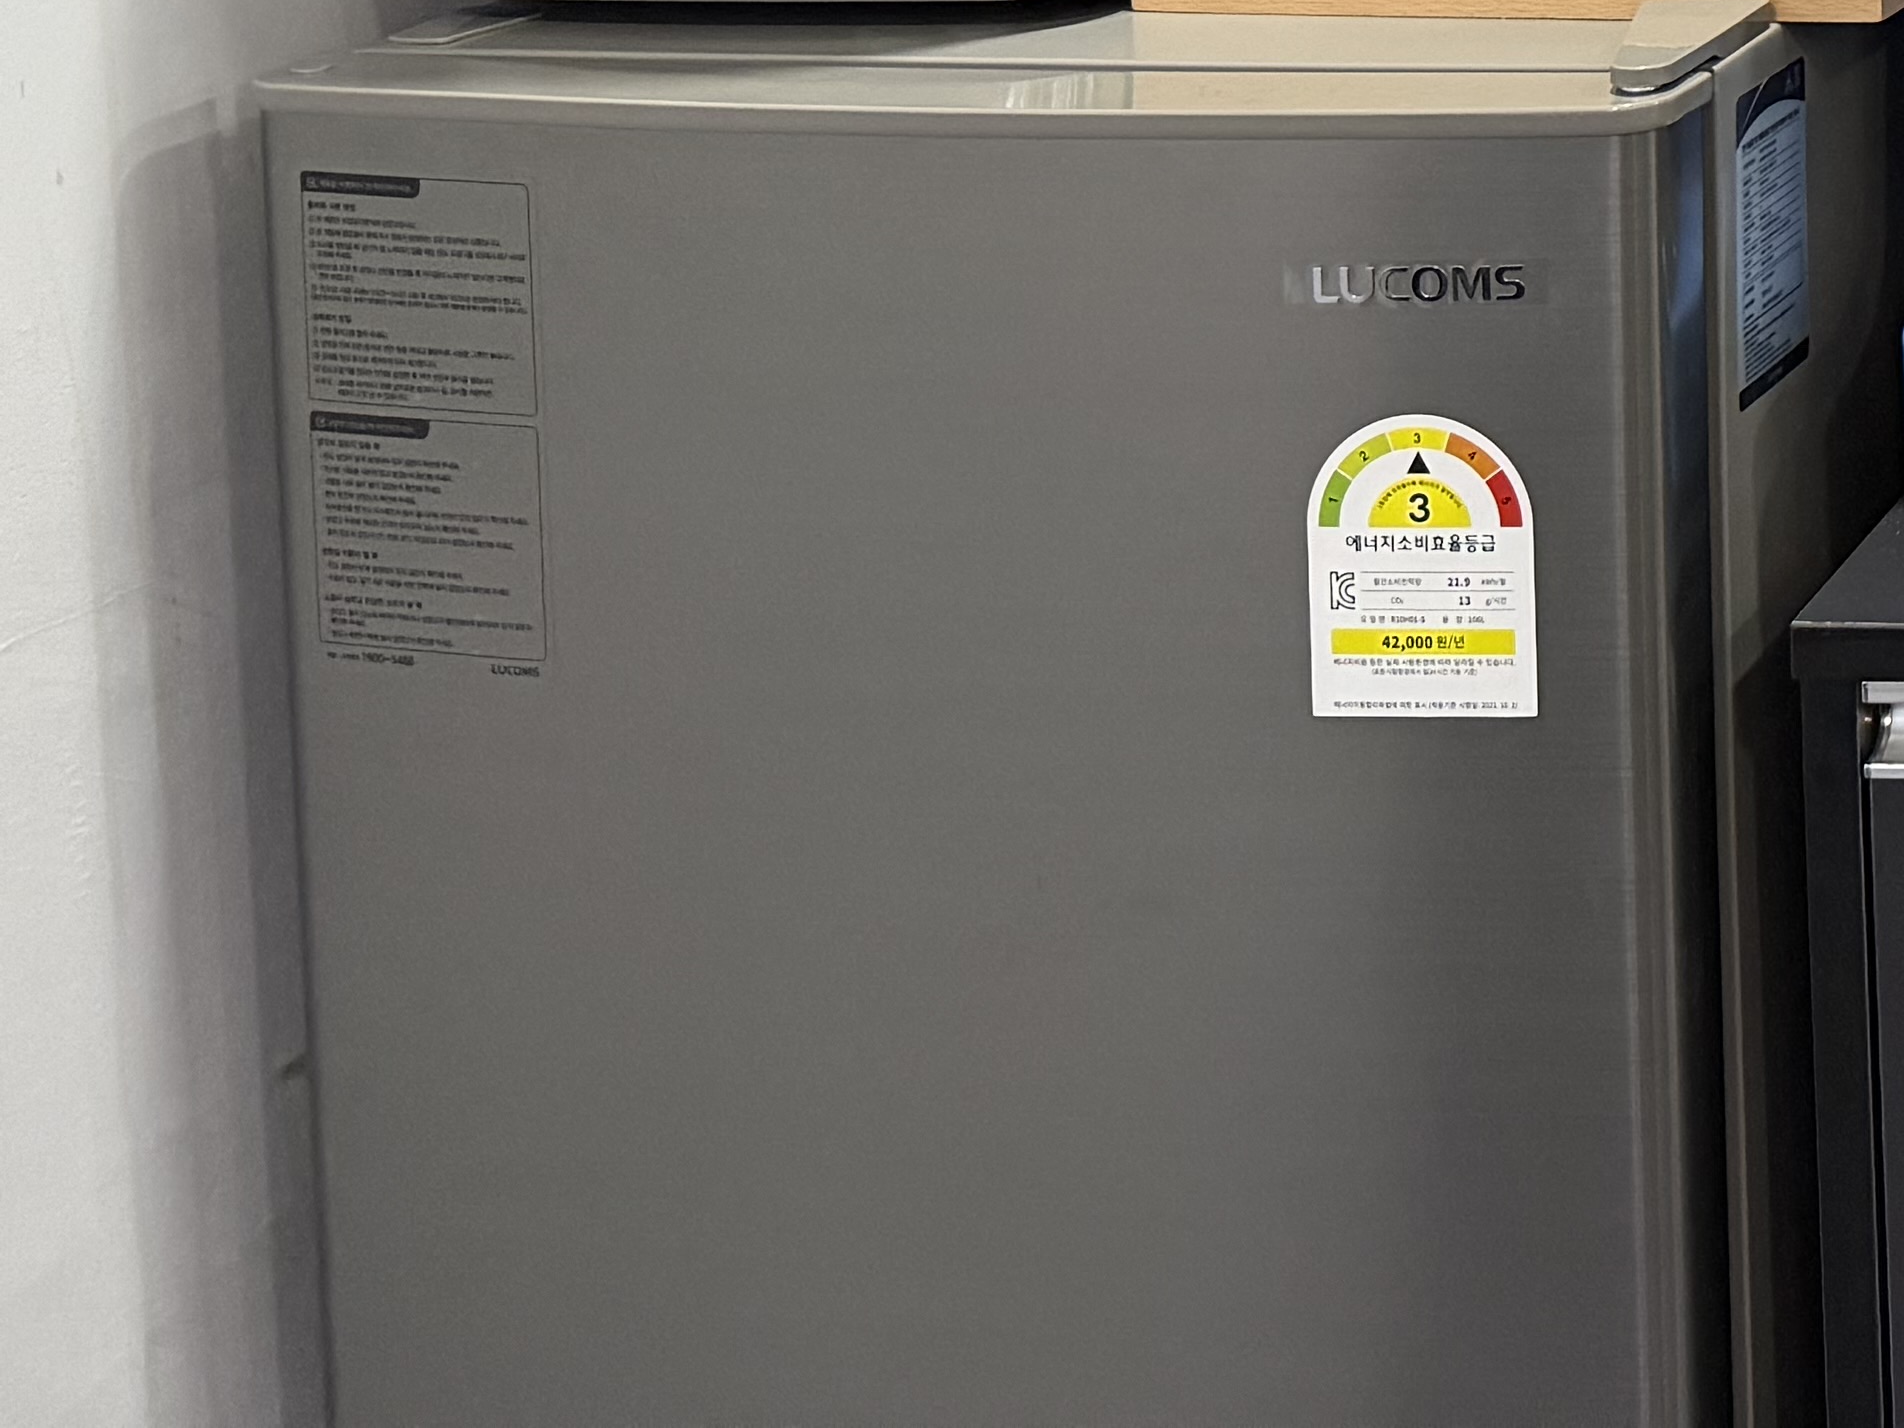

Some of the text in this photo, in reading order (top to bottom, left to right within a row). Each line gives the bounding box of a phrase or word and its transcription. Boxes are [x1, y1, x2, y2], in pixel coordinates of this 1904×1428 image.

[1312, 264, 1525, 305] LUCOMS
[1358, 450, 1371, 463] 2
[1413, 432, 1422, 444] 3
[1408, 492, 1430, 523] 3
[1345, 534, 1496, 553] 에너지소비효율등급
[1381, 633, 1466, 652] 42,000 원/년
